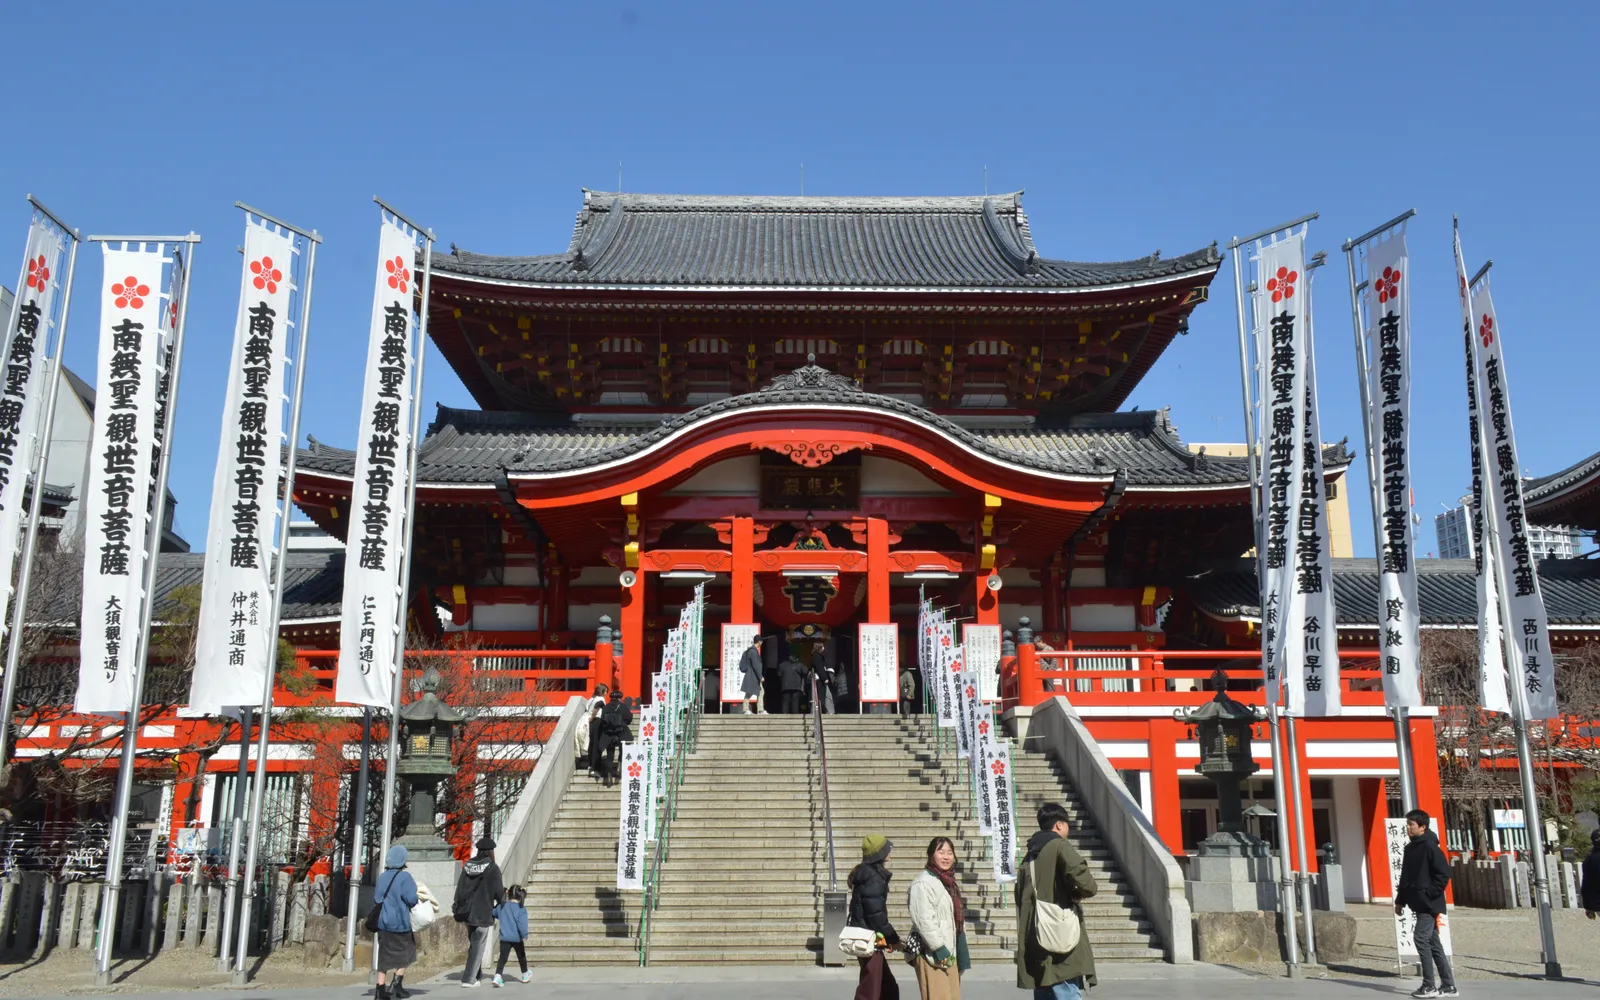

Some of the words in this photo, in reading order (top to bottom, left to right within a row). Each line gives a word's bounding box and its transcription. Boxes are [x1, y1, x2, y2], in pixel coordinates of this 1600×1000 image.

[0, 299, 42, 511] 南無聖観世
[100, 318, 144, 576] 南無聖観世音菩薩
[230, 301, 277, 569] 南無聖観世音菩薩
[359, 301, 408, 571] 南無聖観世音菩薩
[103, 595, 123, 683] 大須観音通り
[229, 591, 248, 666] 仲井通商
[248, 591, 260, 626] 株式会社
[359, 595, 376, 675] 仁王門通り
[624, 778, 641, 879] 南無聖観世音菩薩
[995, 775, 1012, 874] 南無聖観世音菩薩
[1387, 822, 1411, 947] 布袋様に下さい
